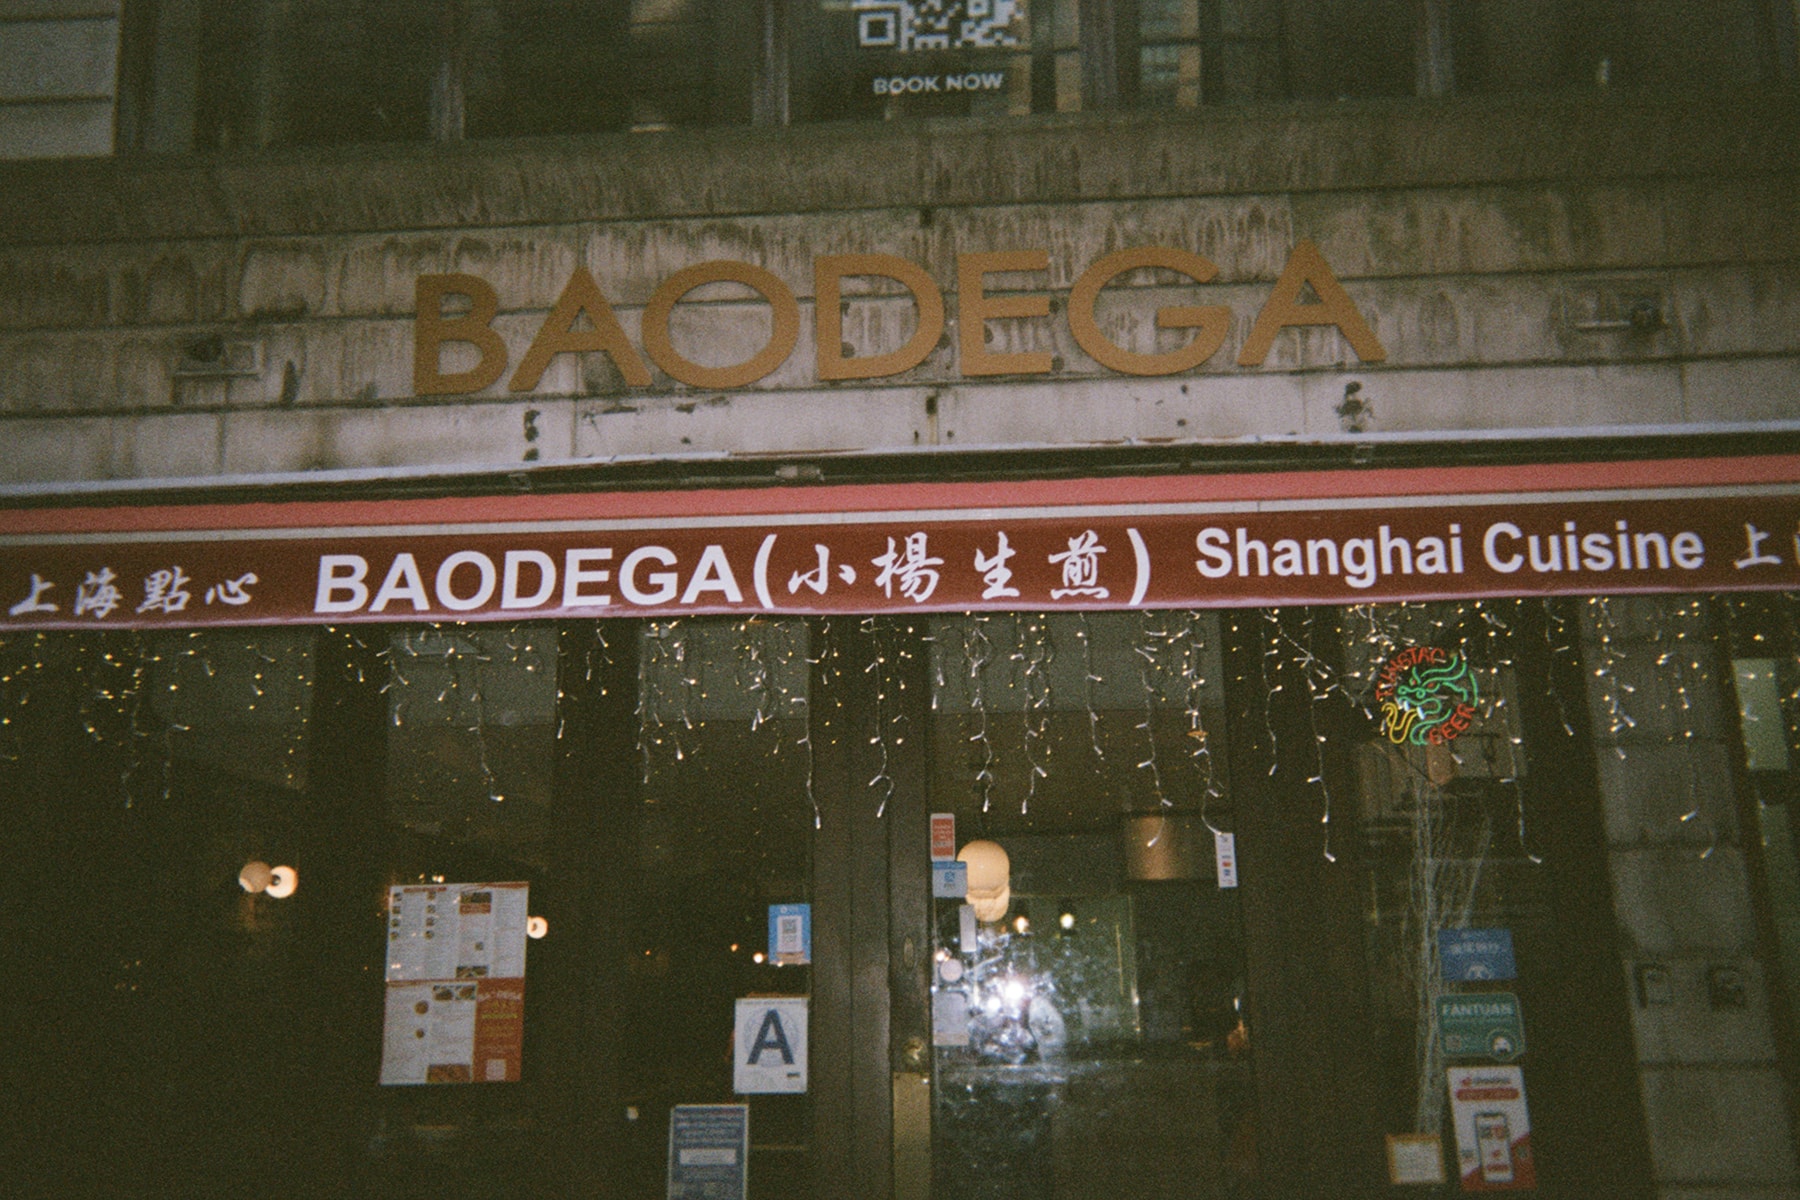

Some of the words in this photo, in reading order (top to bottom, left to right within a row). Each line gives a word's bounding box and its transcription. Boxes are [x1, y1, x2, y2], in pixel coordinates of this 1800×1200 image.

[873, 76, 940, 95] BOOK
[946, 73, 1003, 91] NOW
[414, 240, 1388, 397] BAODEGA
[8, 566, 259, 616] 上海點心
[1195, 523, 1463, 589] Shanghai
[1482, 520, 1704, 574] Cuisine
[746, 1008, 796, 1065] A
